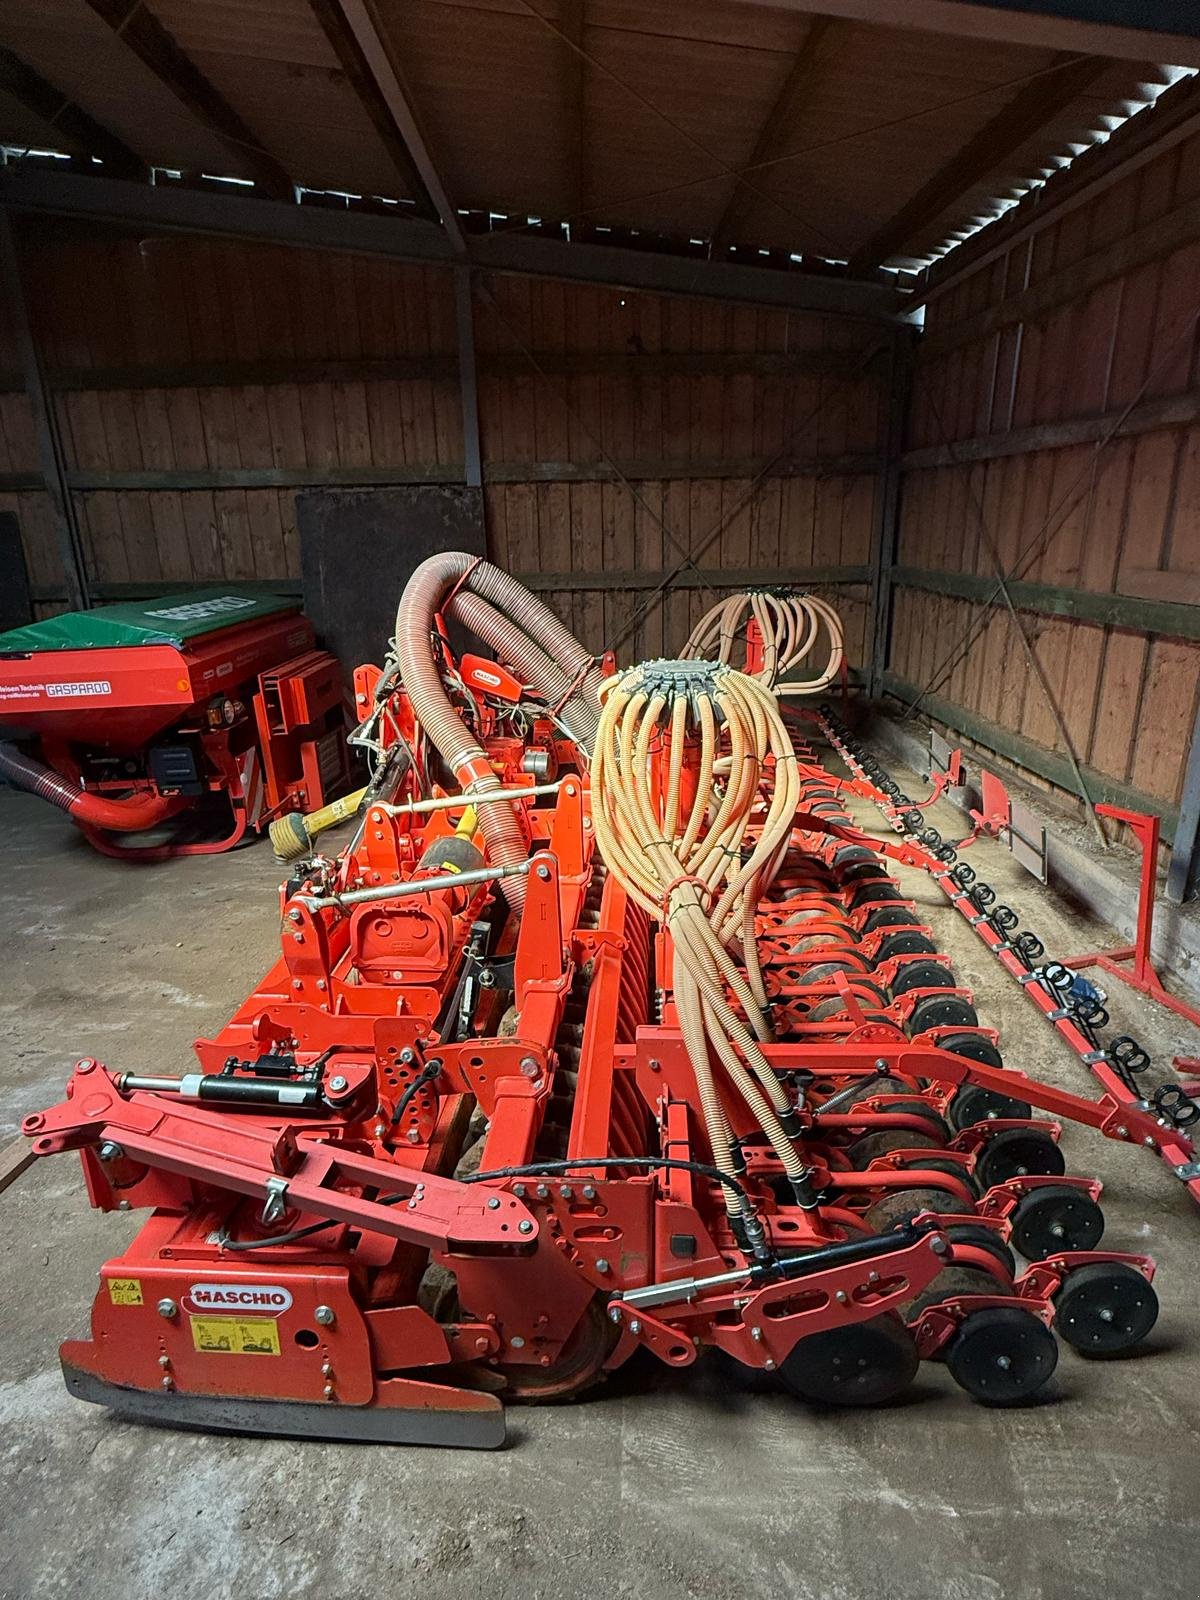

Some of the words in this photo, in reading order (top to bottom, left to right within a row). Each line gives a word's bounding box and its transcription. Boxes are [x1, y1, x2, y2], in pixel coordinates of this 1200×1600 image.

[20, 684, 45, 692] Technik
[47, 682, 110, 696] GASPARDO
[193, 1290, 286, 1305] MASCHIO
